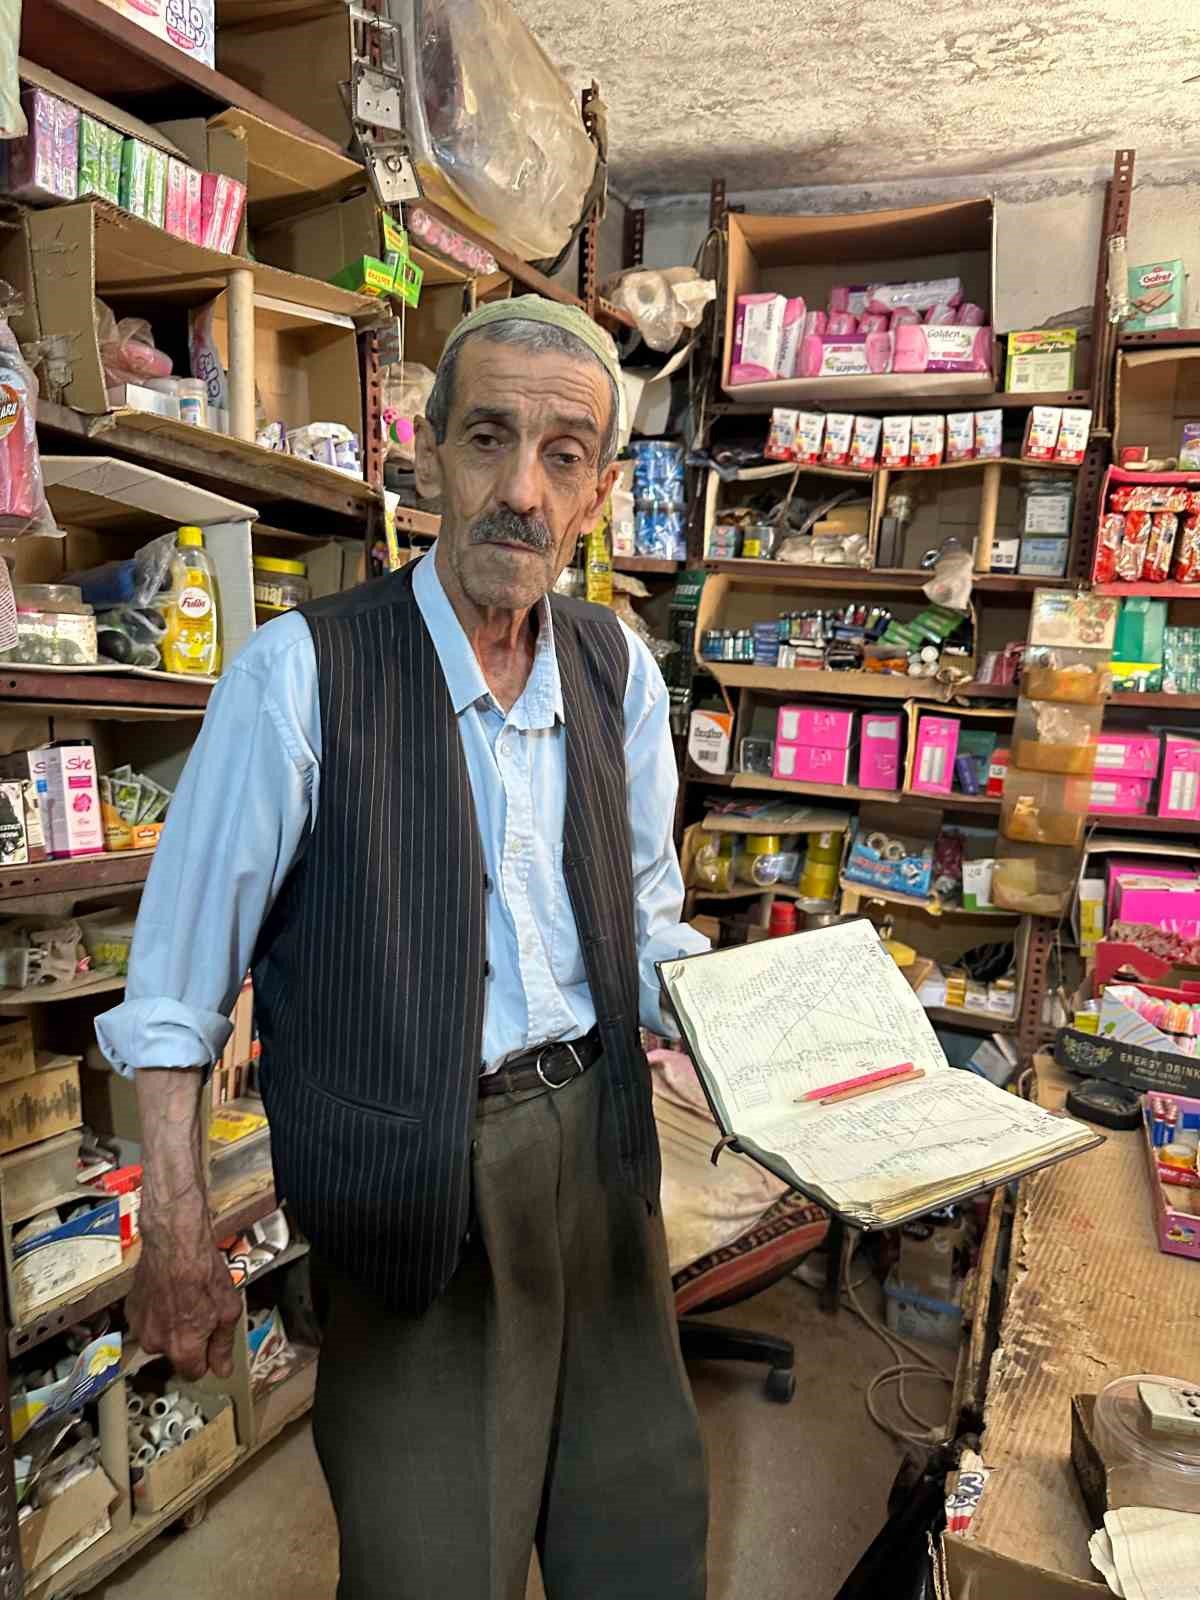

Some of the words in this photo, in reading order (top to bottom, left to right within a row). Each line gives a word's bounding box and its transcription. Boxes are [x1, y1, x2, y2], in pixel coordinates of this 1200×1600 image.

[166, 6, 206, 48] baby
[928, 328, 961, 339] Golden
[65, 756, 93, 770] She
